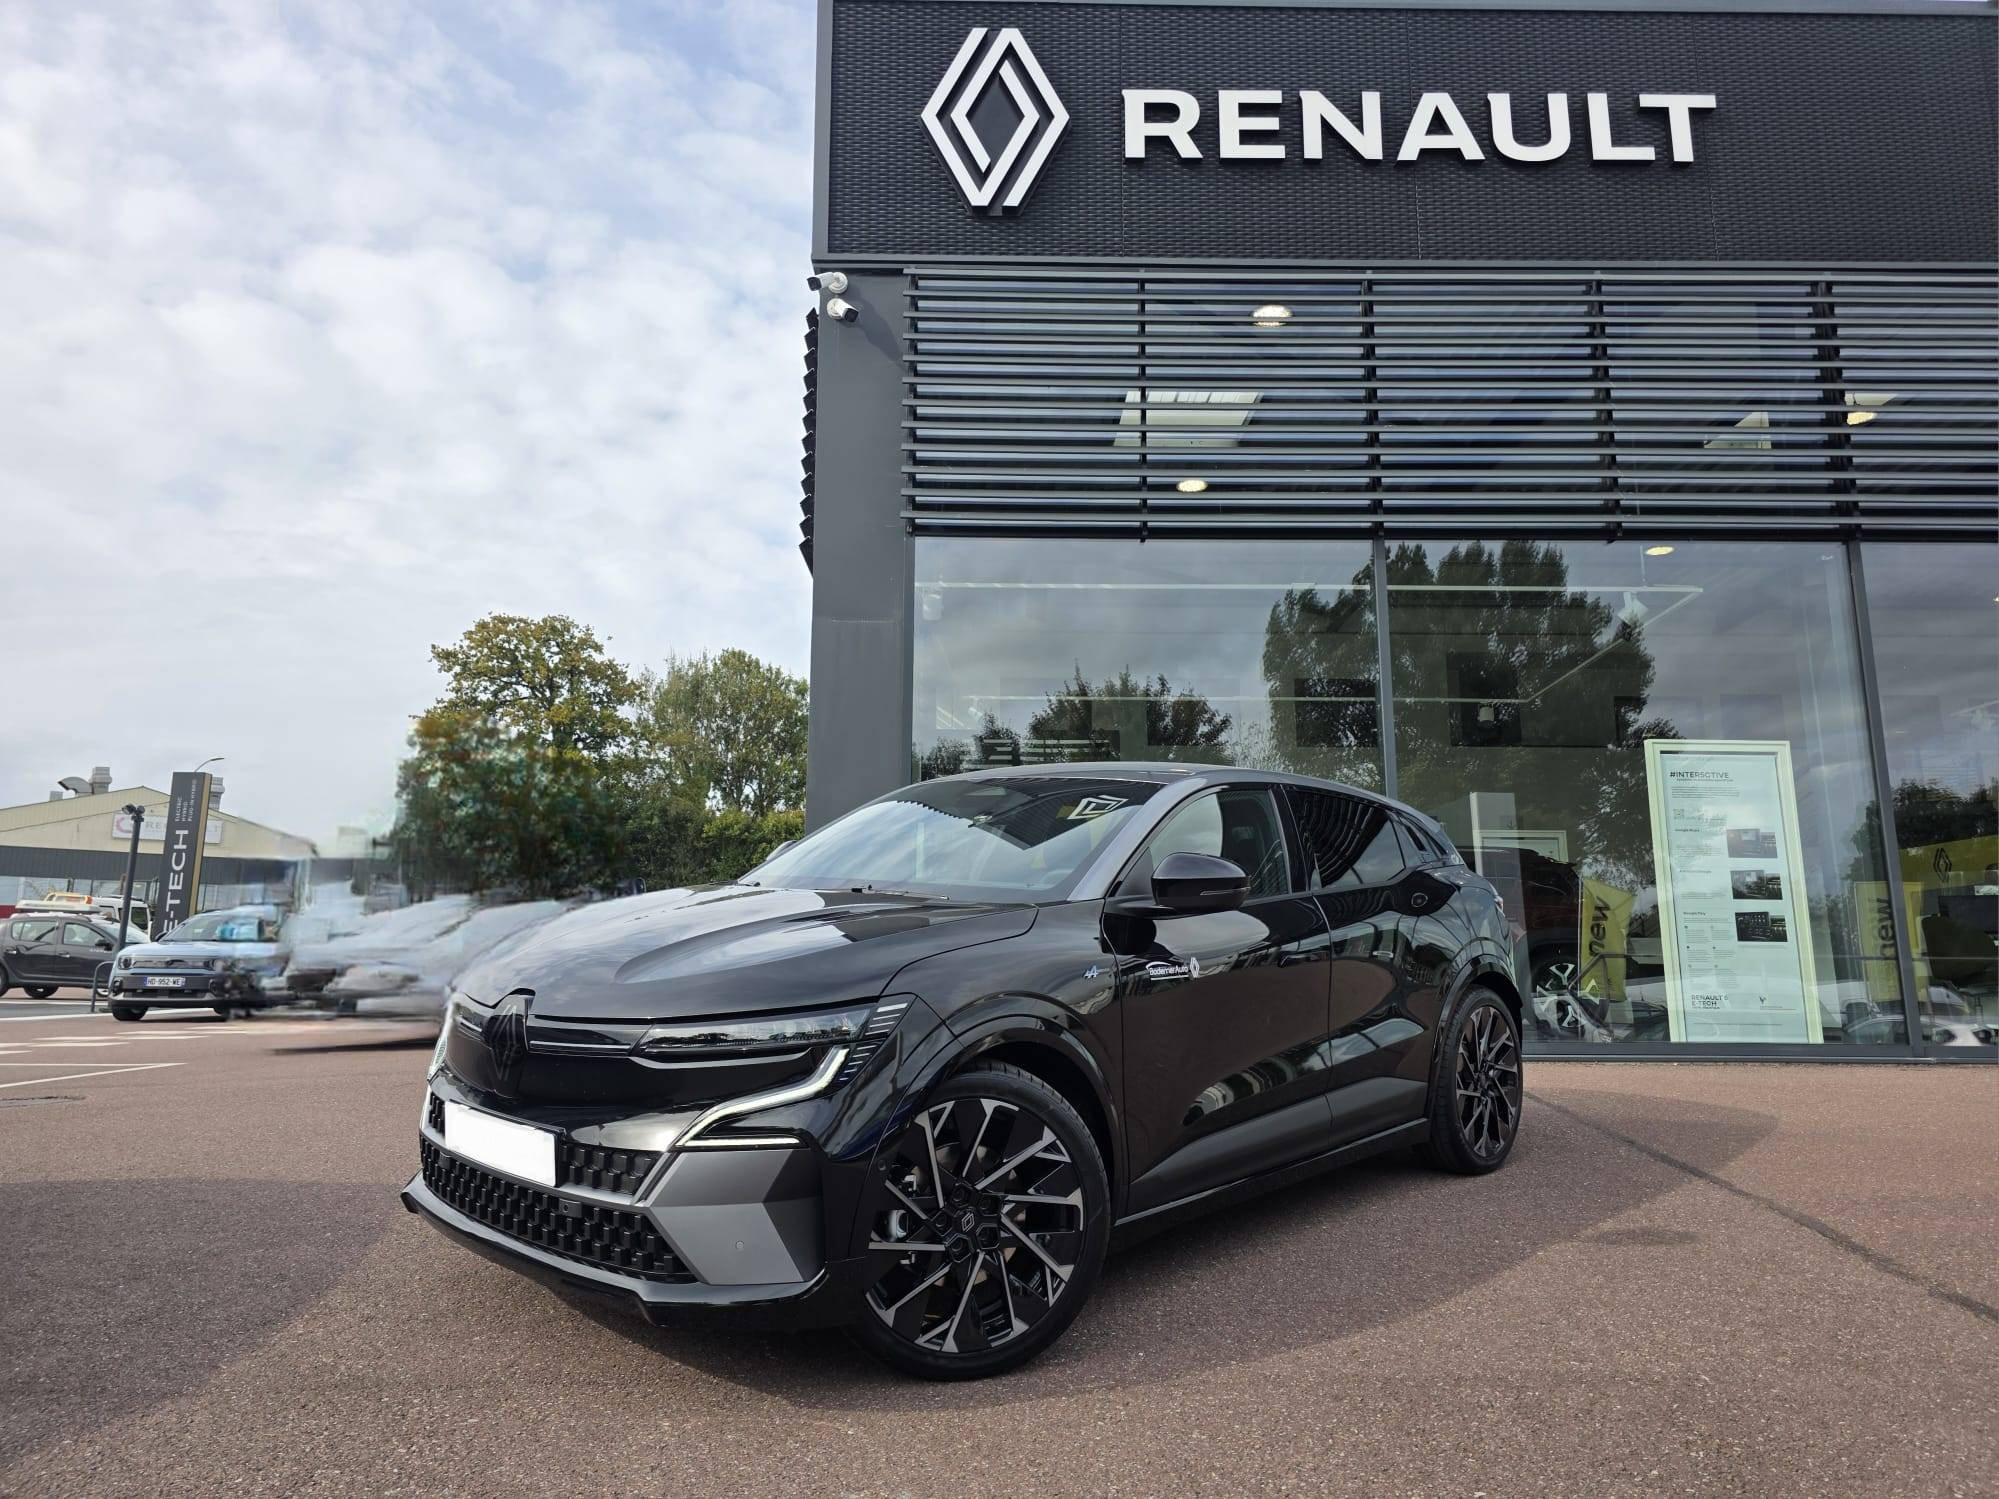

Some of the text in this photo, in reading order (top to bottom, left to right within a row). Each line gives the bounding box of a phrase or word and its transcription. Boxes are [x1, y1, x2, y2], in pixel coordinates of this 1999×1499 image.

[1122, 89, 1718, 164] RENAULT
[163, 829, 189, 933] E-TECH
[1588, 896, 1611, 957] new
[1876, 898, 1896, 960] new
